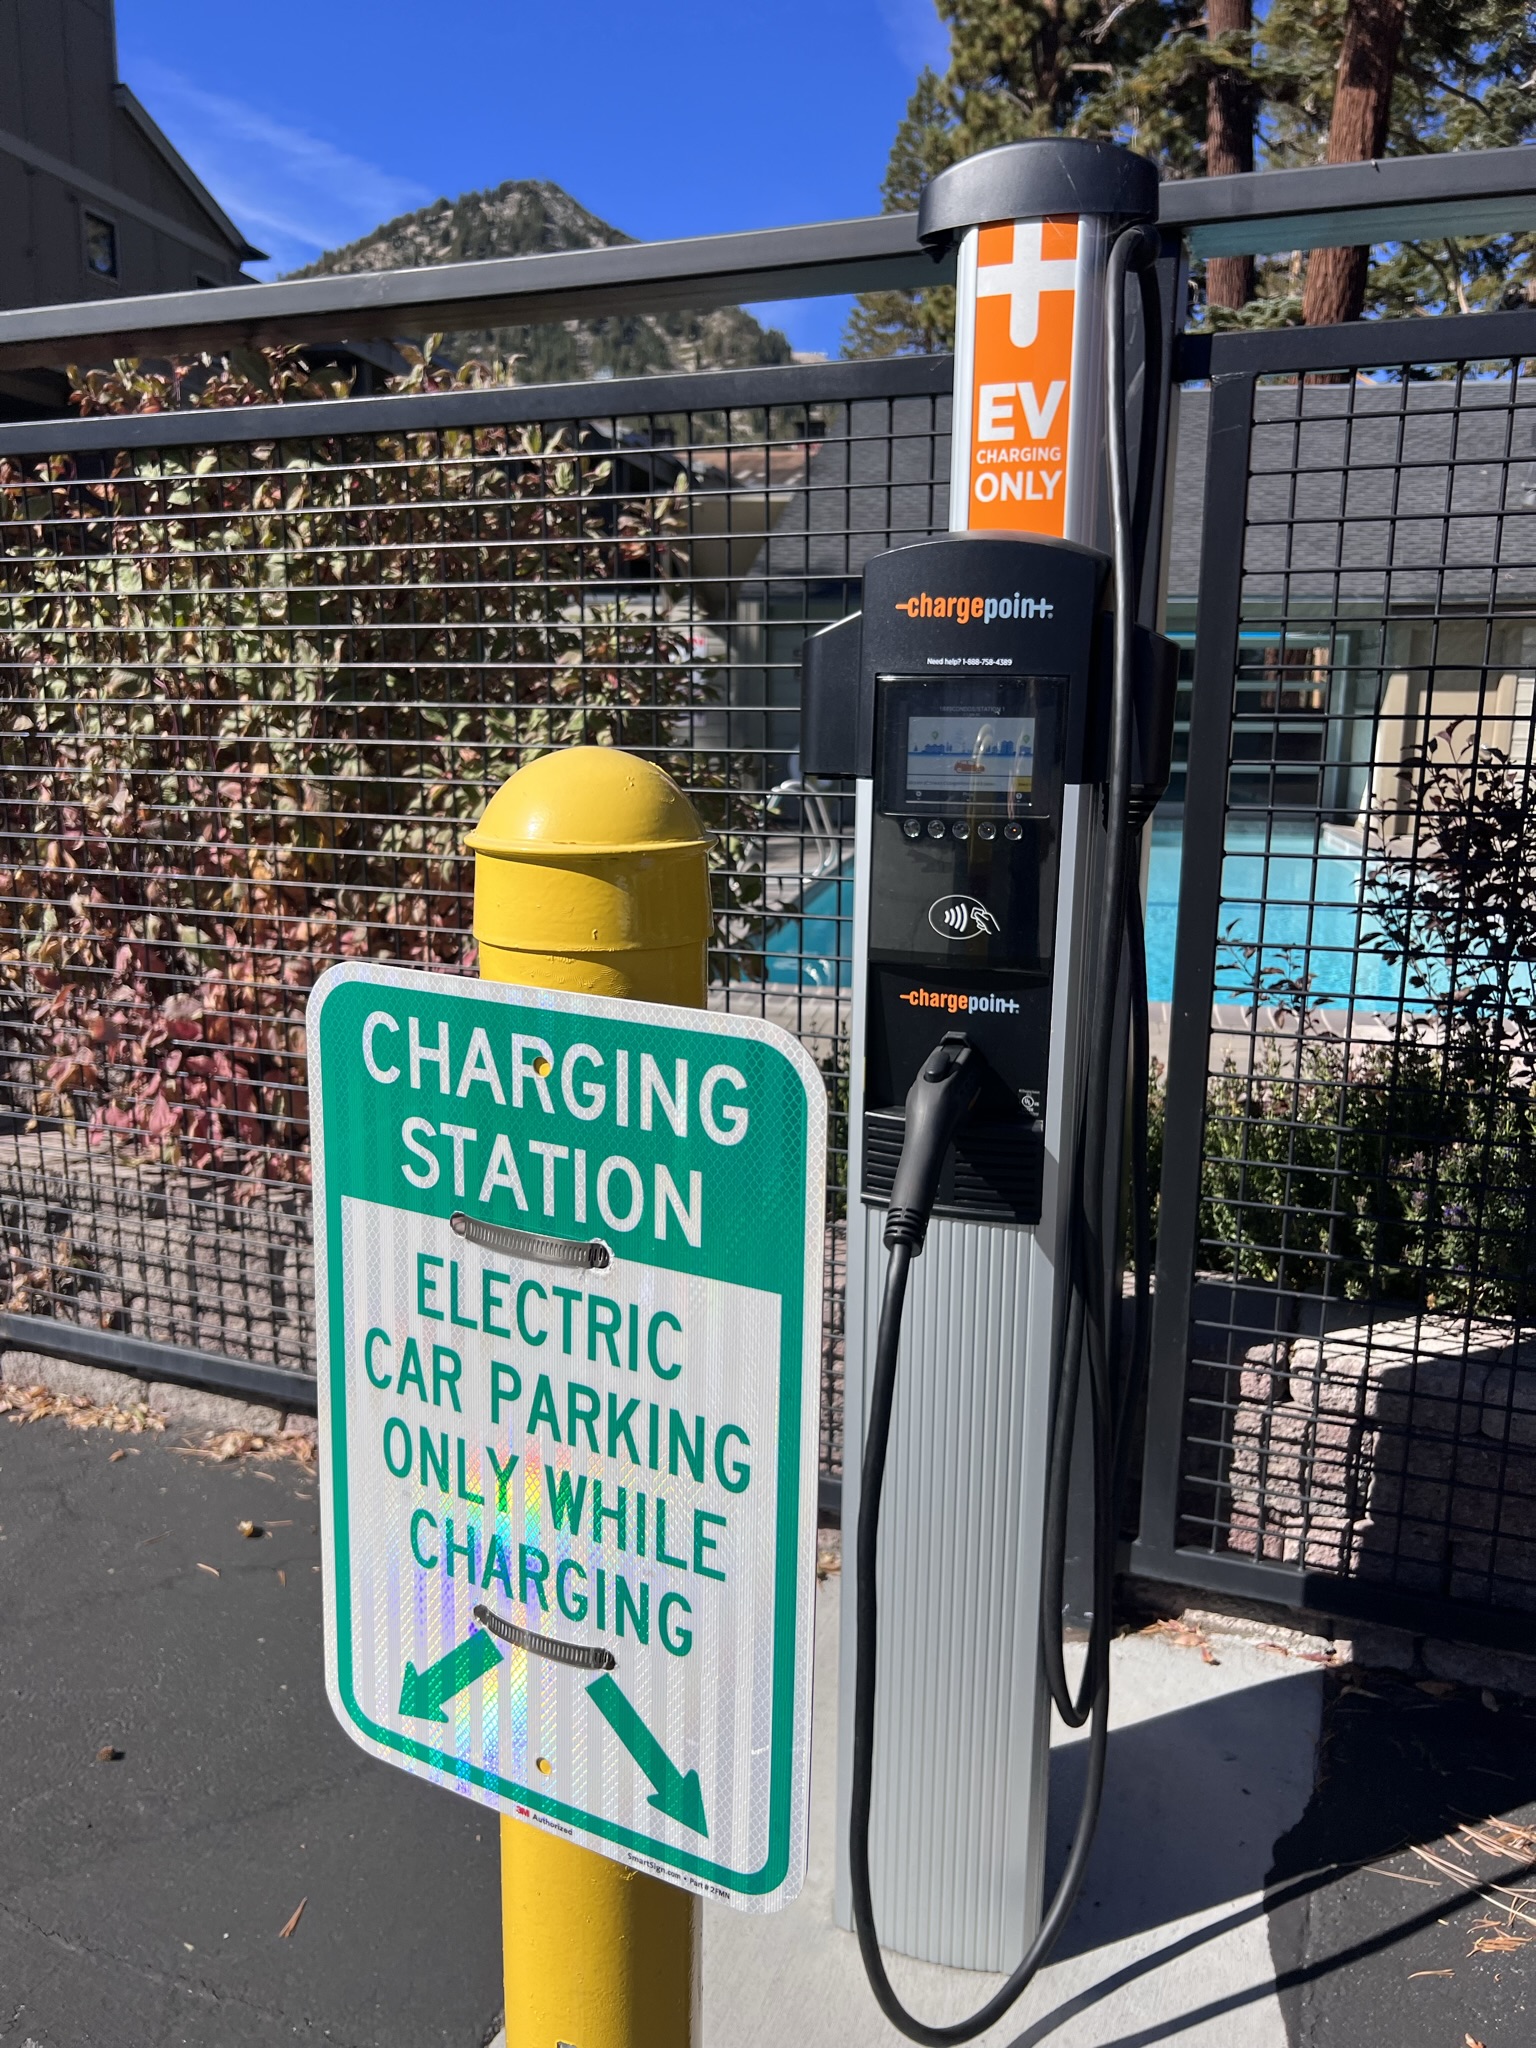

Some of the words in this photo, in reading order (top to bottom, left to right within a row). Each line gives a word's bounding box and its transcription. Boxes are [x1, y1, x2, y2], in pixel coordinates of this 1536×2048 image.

[976, 446, 1061, 465] CHARGING
[977, 380, 1067, 442] EV
[974, 470, 1063, 503] ONLY
[926, 657, 944, 665] Need
[944, 657, 961, 666] help?
[962, 658, 1013, 666] 1-888-758-4389
[362, 1010, 749, 1147] CHARGING
[401, 1116, 702, 1248] STATION
[417, 1252, 683, 1381] ELECTRIC
[364, 1327, 462, 1413] CAR
[490, 1360, 751, 1494] PARKING
[383, 1417, 519, 1514] ONLY
[545, 1464, 727, 1582] WHILE
[410, 1508, 693, 1657] CHARGING
[515, 1805, 530, 1818] 3M
[532, 1813, 573, 1836] Authorized
[627, 1852, 681, 1880] SmartSign.com
[689, 1877, 703, 1890] Part
